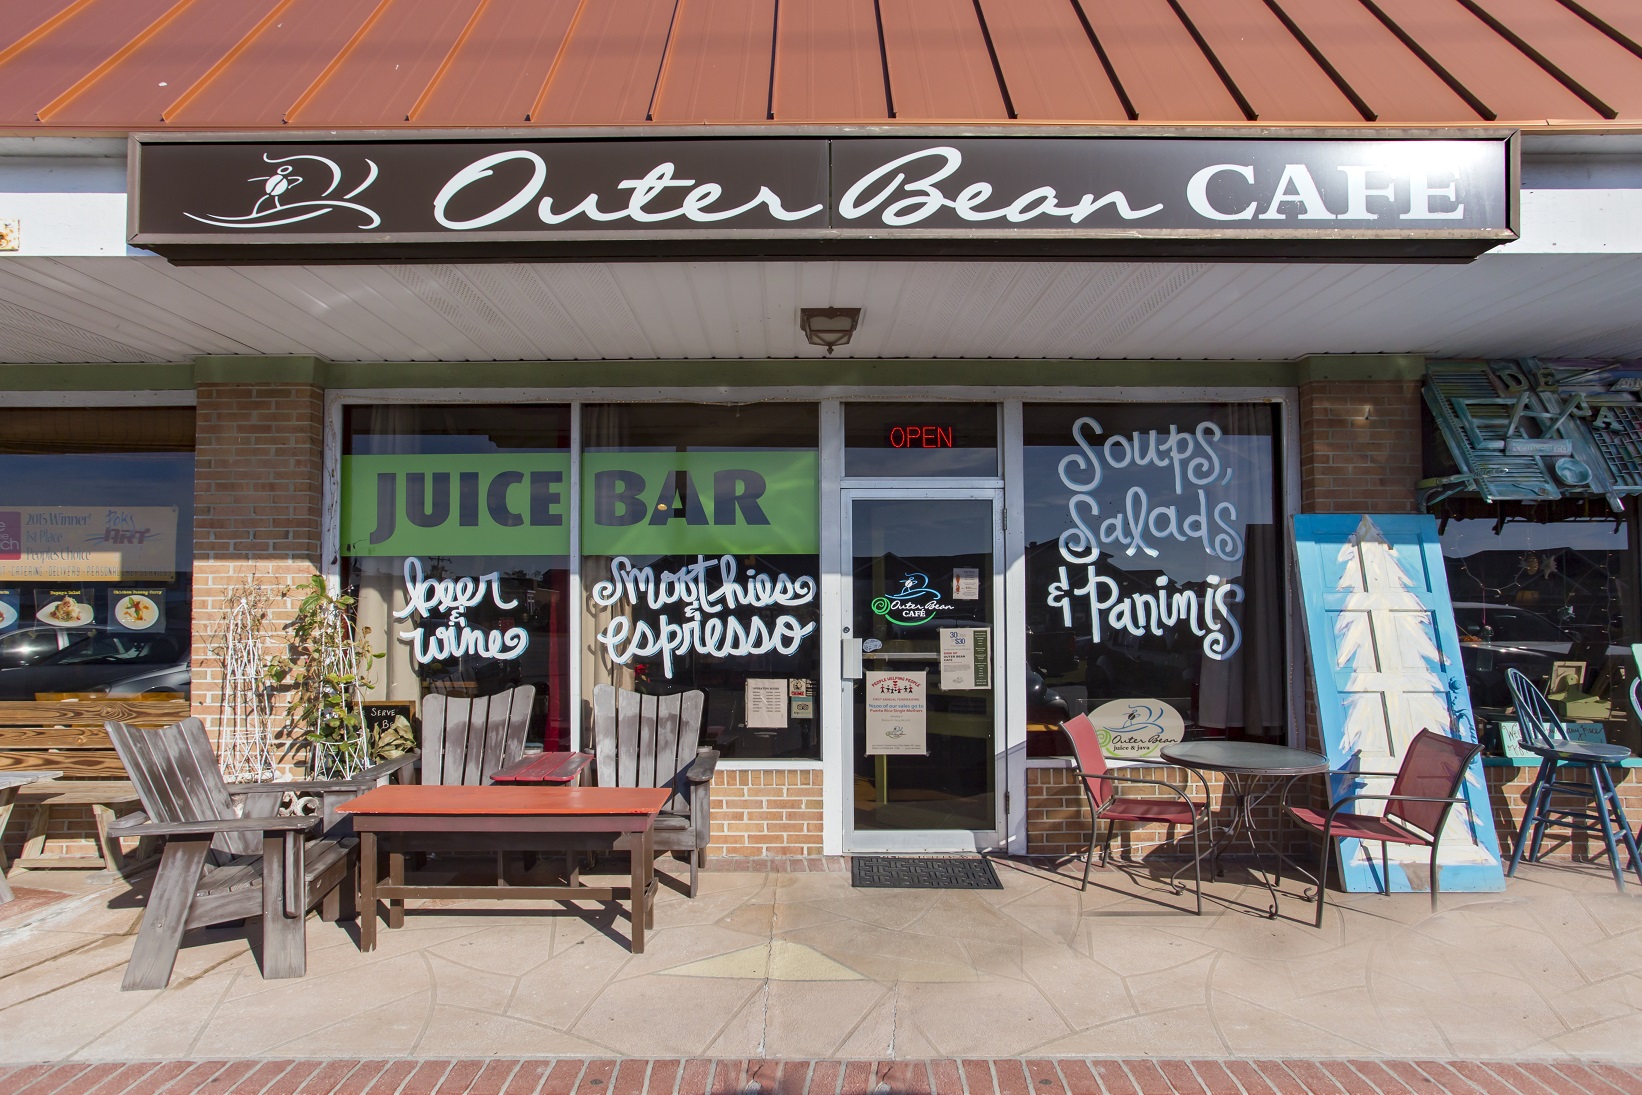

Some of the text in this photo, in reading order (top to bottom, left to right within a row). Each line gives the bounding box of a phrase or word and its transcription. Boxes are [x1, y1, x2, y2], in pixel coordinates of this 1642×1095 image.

[433, 150, 824, 230] Outer
[838, 146, 1164, 226] Bean
[890, 426, 953, 448] OPEN
[1058, 416, 1234, 495] Soups,
[369, 469, 772, 545] JUICE BAR
[26, 512, 48, 526] 2015
[1058, 486, 1245, 564] Salads
[40, 529, 63, 543] Place
[61, 546, 91, 560] Choice
[11, 566, 43, 576] CATERING
[48, 566, 80, 576] DELIVERY
[86, 566, 120, 576] PERSONAL
[393, 556, 519, 618] beer
[890, 600, 955, 610] Outer Bean
[902, 609, 926, 617] CAFÉ
[1047, 565, 1073, 628] &
[1074, 565, 1246, 661] Paninis
[400, 621, 530, 665] wine
[597, 614, 817, 680] espresso
[954, 637, 966, 645] $30
[370, 707, 396, 717] SERVE
[1111, 734, 1179, 744] Outer Bean
